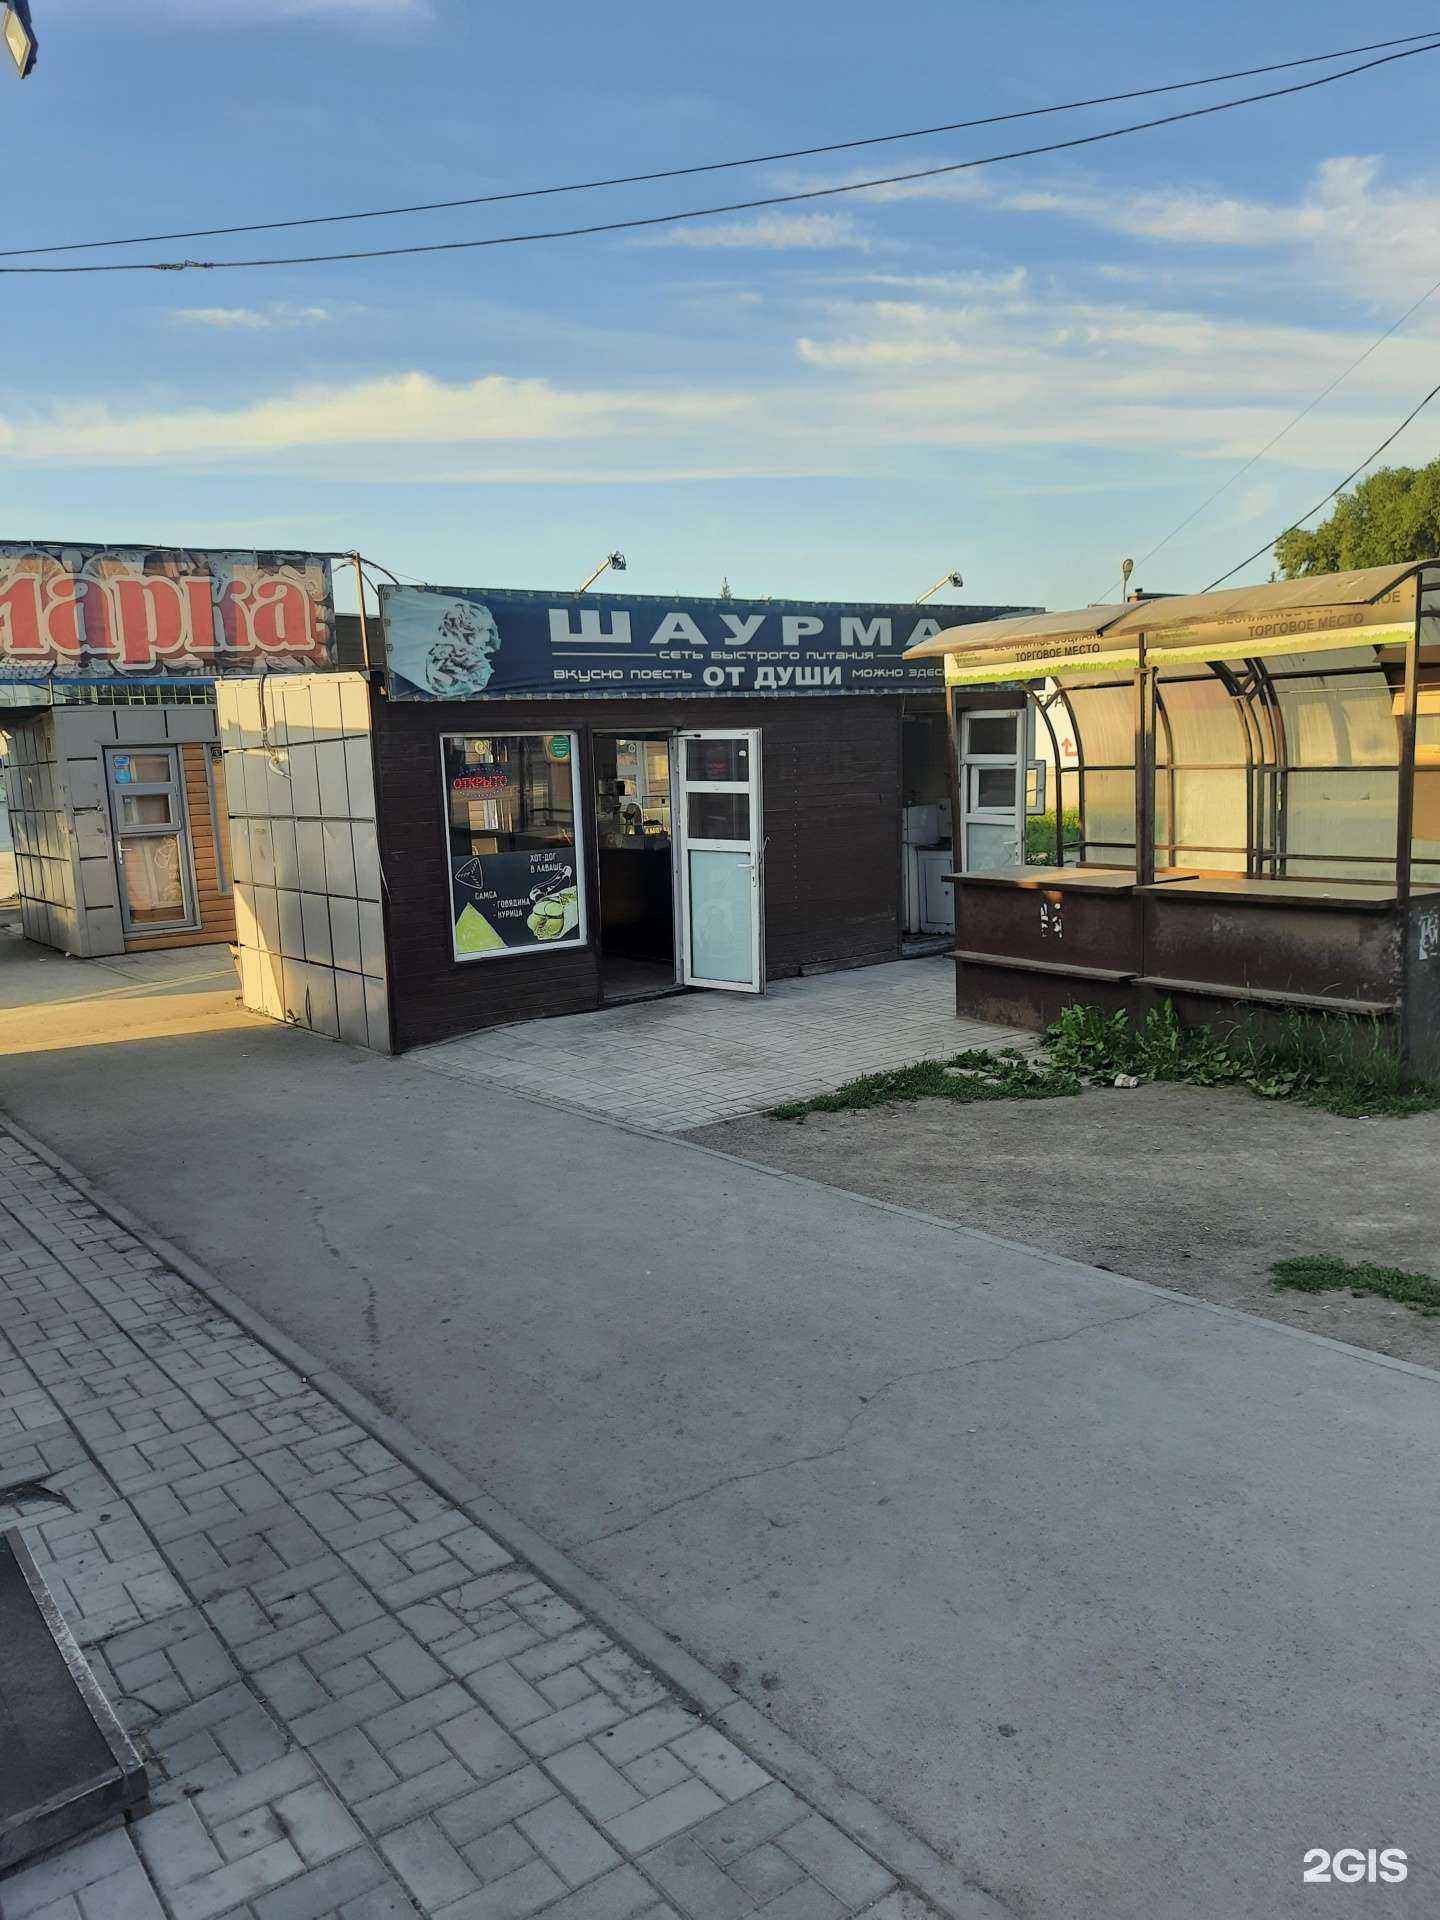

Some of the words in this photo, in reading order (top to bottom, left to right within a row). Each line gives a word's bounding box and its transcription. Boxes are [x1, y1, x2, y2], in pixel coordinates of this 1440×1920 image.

[548, 608, 945, 648] ШАУРМА
[1247, 615, 1317, 637] ТОРГОВОЕ
[1318, 612, 1364, 629] МЕСТО
[1016, 648, 1062, 662] ТОРГОВОЕ
[1064, 643, 1100, 656] МЕСТО
[702, 666, 746, 687] ОТ
[753, 666, 842, 690] ДУШИ
[474, 891, 498, 900] САМСА
[497, 899, 531, 908] ГОВЯДИНА
[498, 910, 522, 919] КУРИЦА
